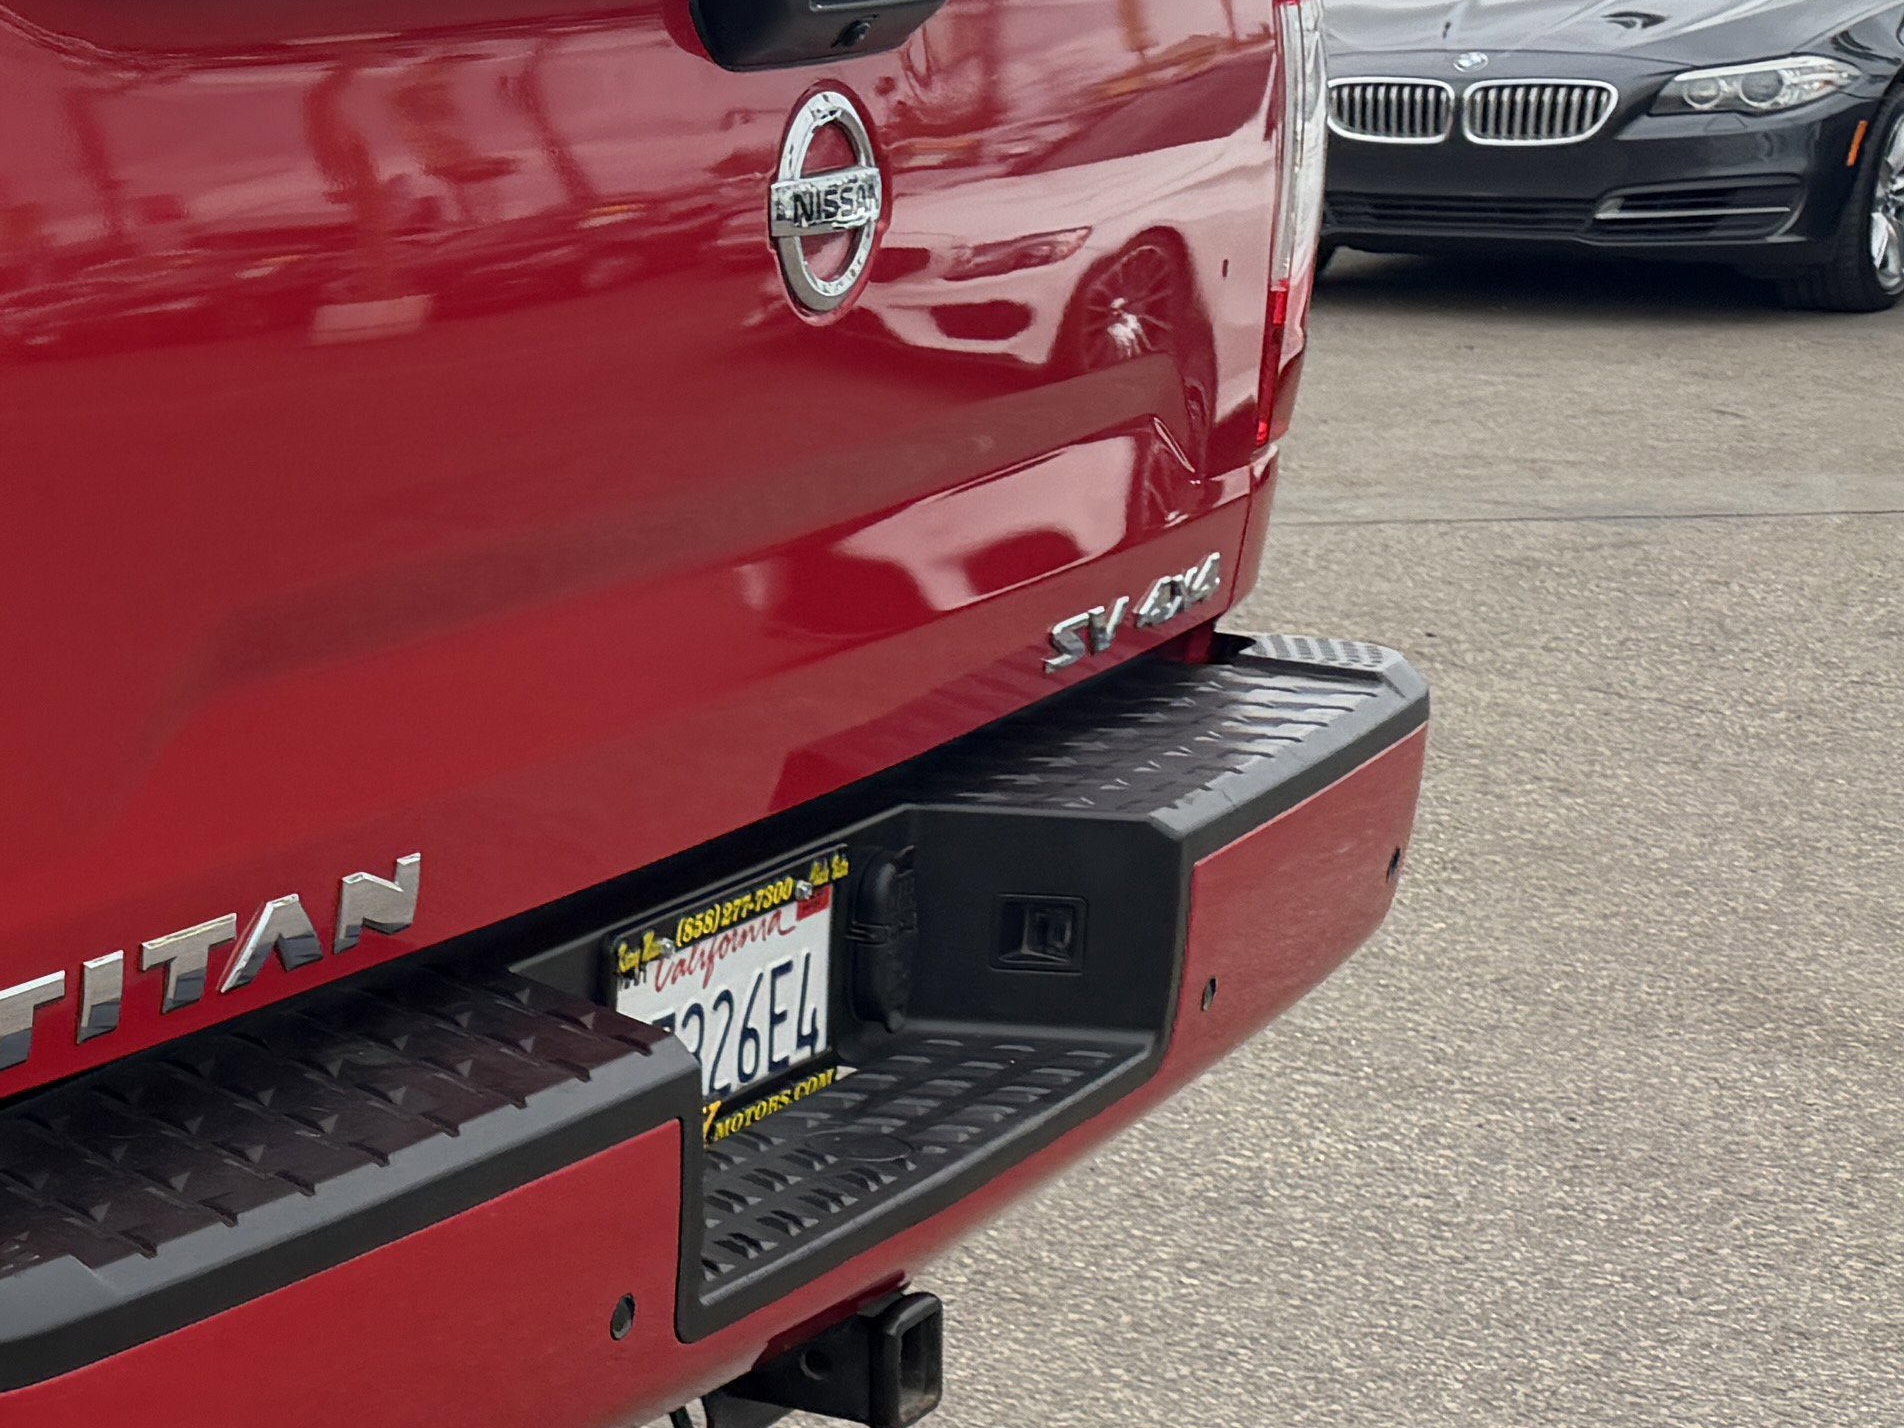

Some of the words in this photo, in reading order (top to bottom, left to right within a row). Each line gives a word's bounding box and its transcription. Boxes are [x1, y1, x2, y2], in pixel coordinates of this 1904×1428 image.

[793, 177, 877, 224] NISSAN
[1041, 595, 1130, 674] SV
[655, 908, 796, 993] California
